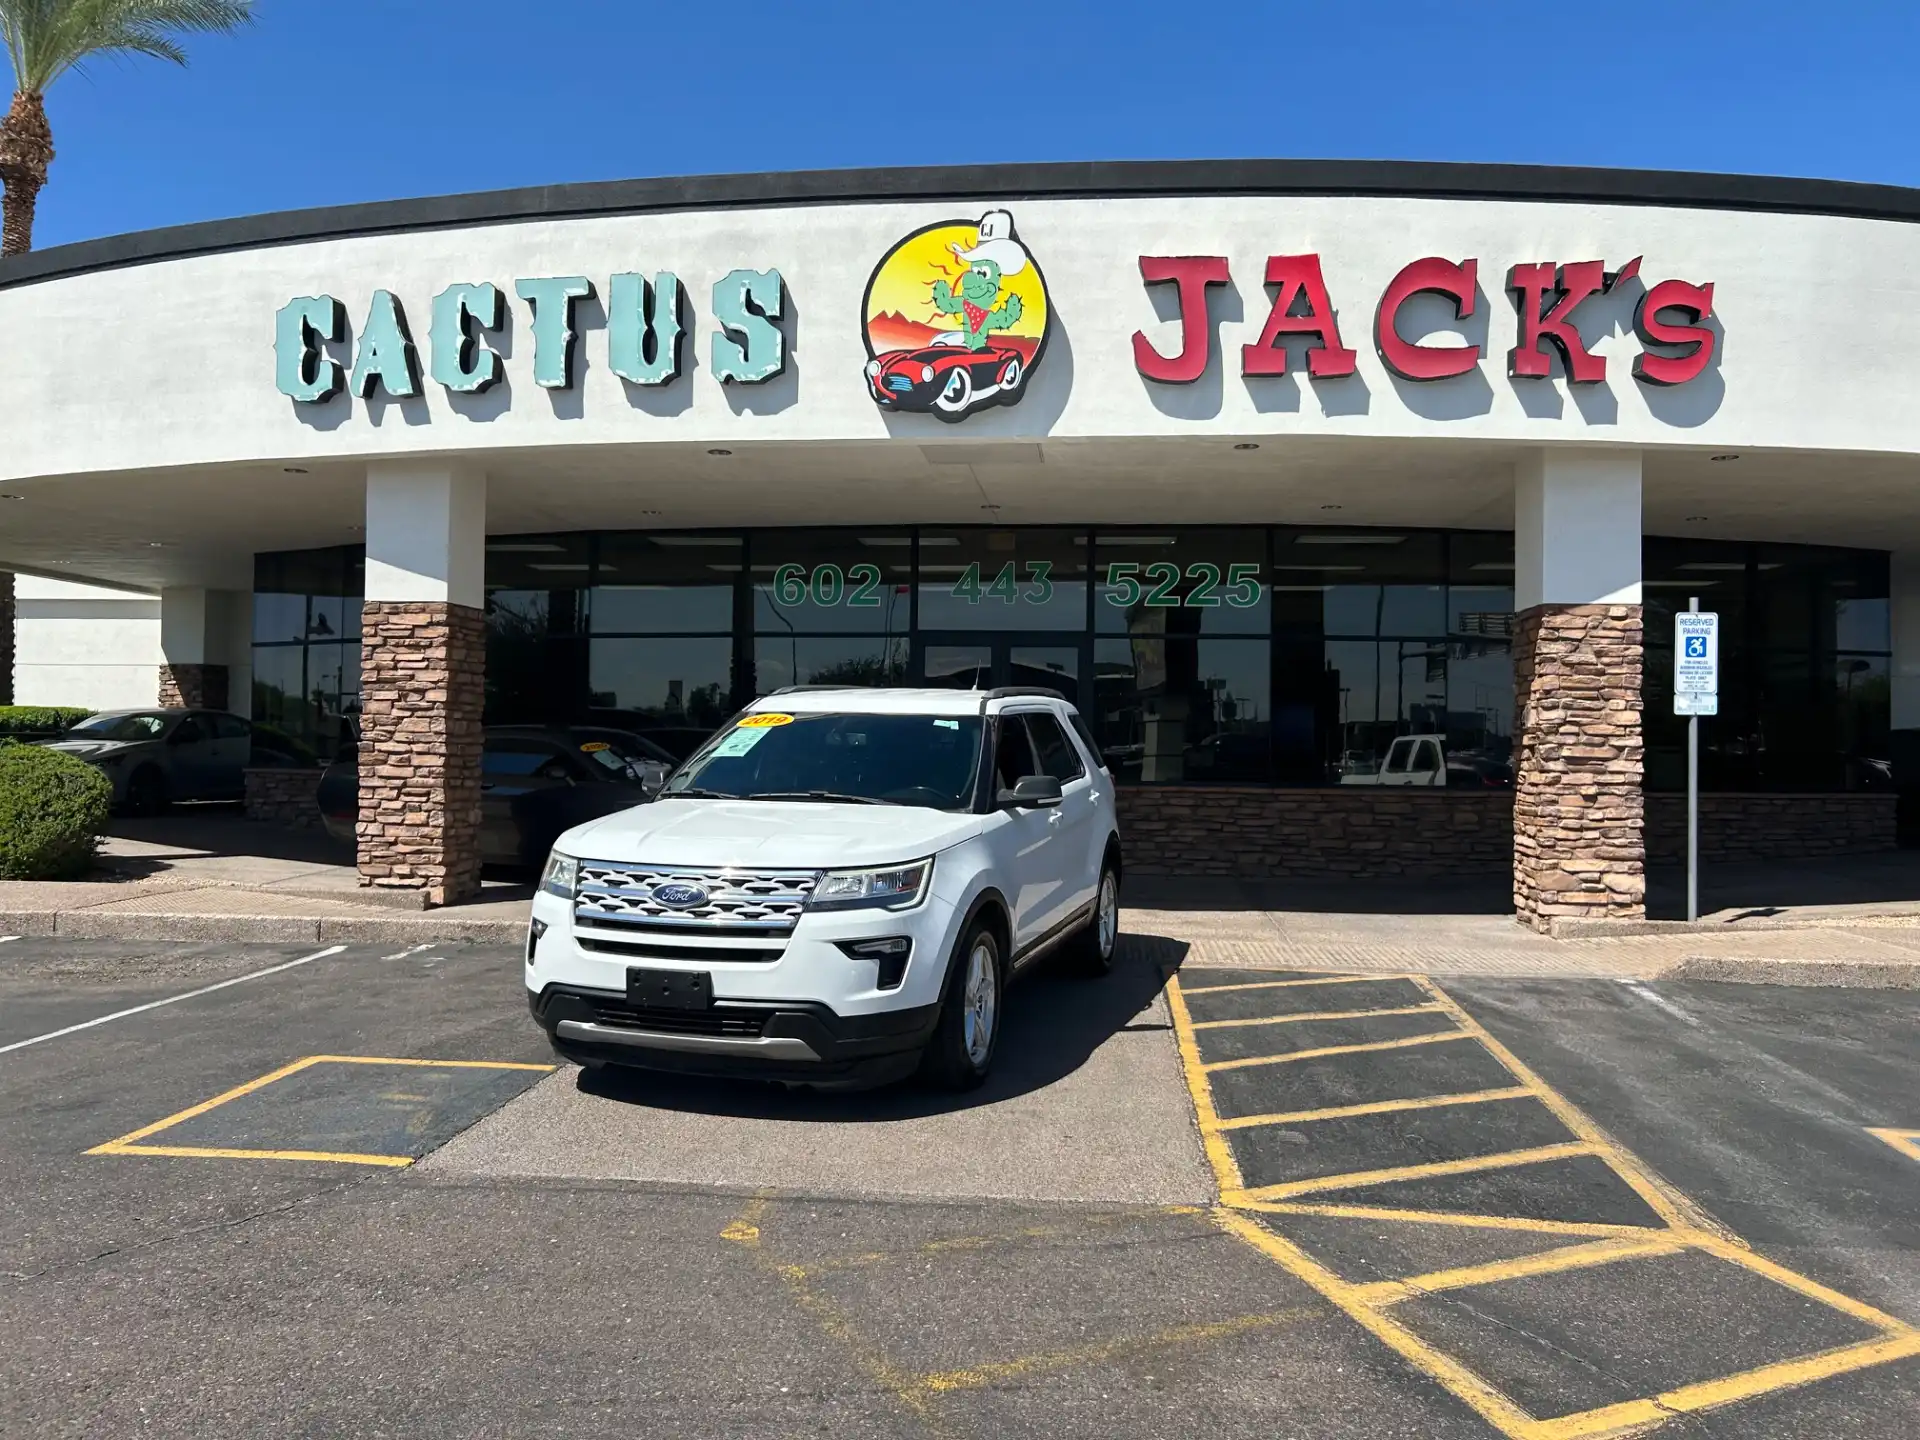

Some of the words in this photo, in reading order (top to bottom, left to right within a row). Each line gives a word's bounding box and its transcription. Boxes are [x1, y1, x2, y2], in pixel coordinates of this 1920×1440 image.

[1132, 254, 1715, 386] JACK'S
[274, 269, 785, 403] CACTUS
[773, 563, 882, 607] 602
[951, 561, 1054, 604] 443
[1104, 563, 1262, 608] 5225
[1679, 618, 1714, 626] RESERVED
[1682, 627, 1711, 635] PARKING
[742, 716, 788, 725] 2019
[661, 886, 692, 901] Ford
